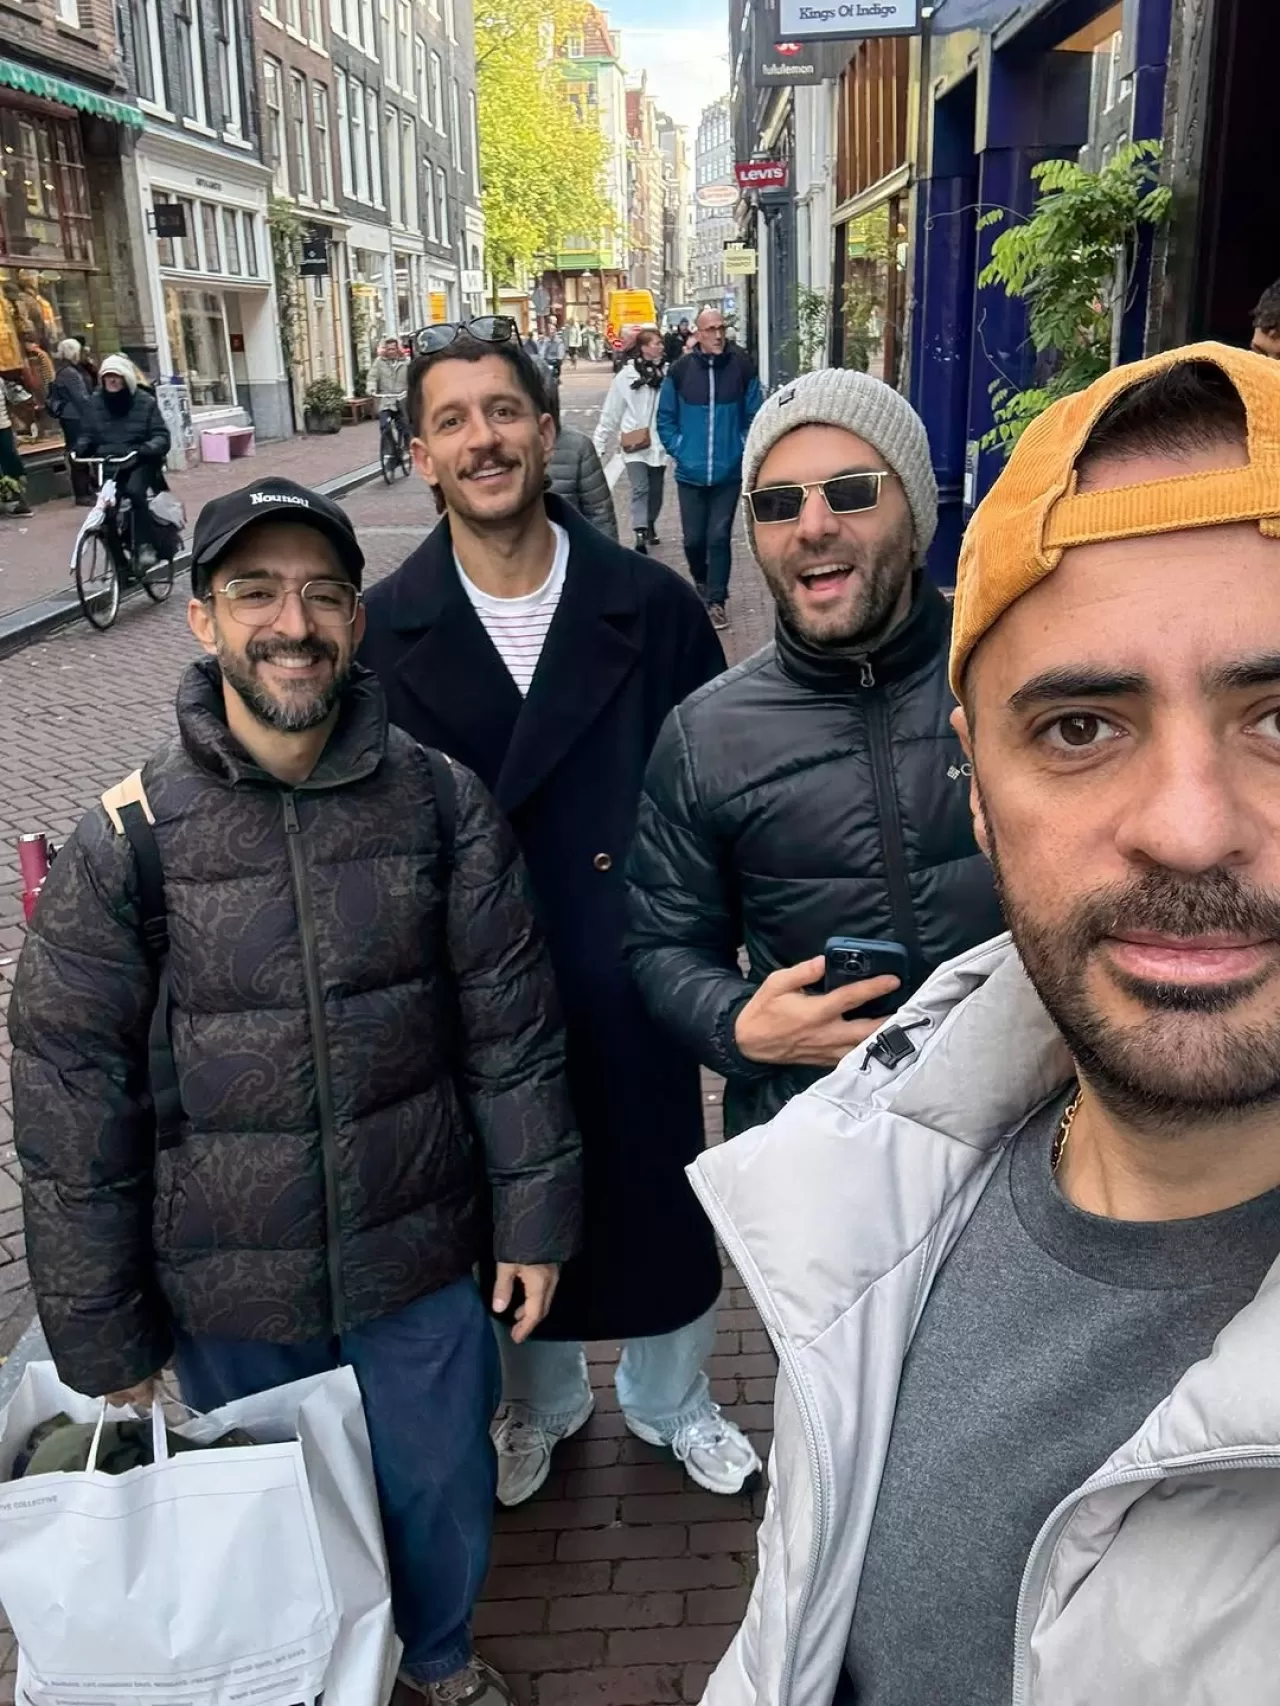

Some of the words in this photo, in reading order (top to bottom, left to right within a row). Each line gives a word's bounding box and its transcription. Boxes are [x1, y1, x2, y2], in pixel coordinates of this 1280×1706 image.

[799, 6, 835, 21] Kings
[838, 6, 853, 17] Of
[856, 4, 897, 18] Indigo
[762, 63, 814, 75] lululemon
[249, 492, 309, 508] Nounou
